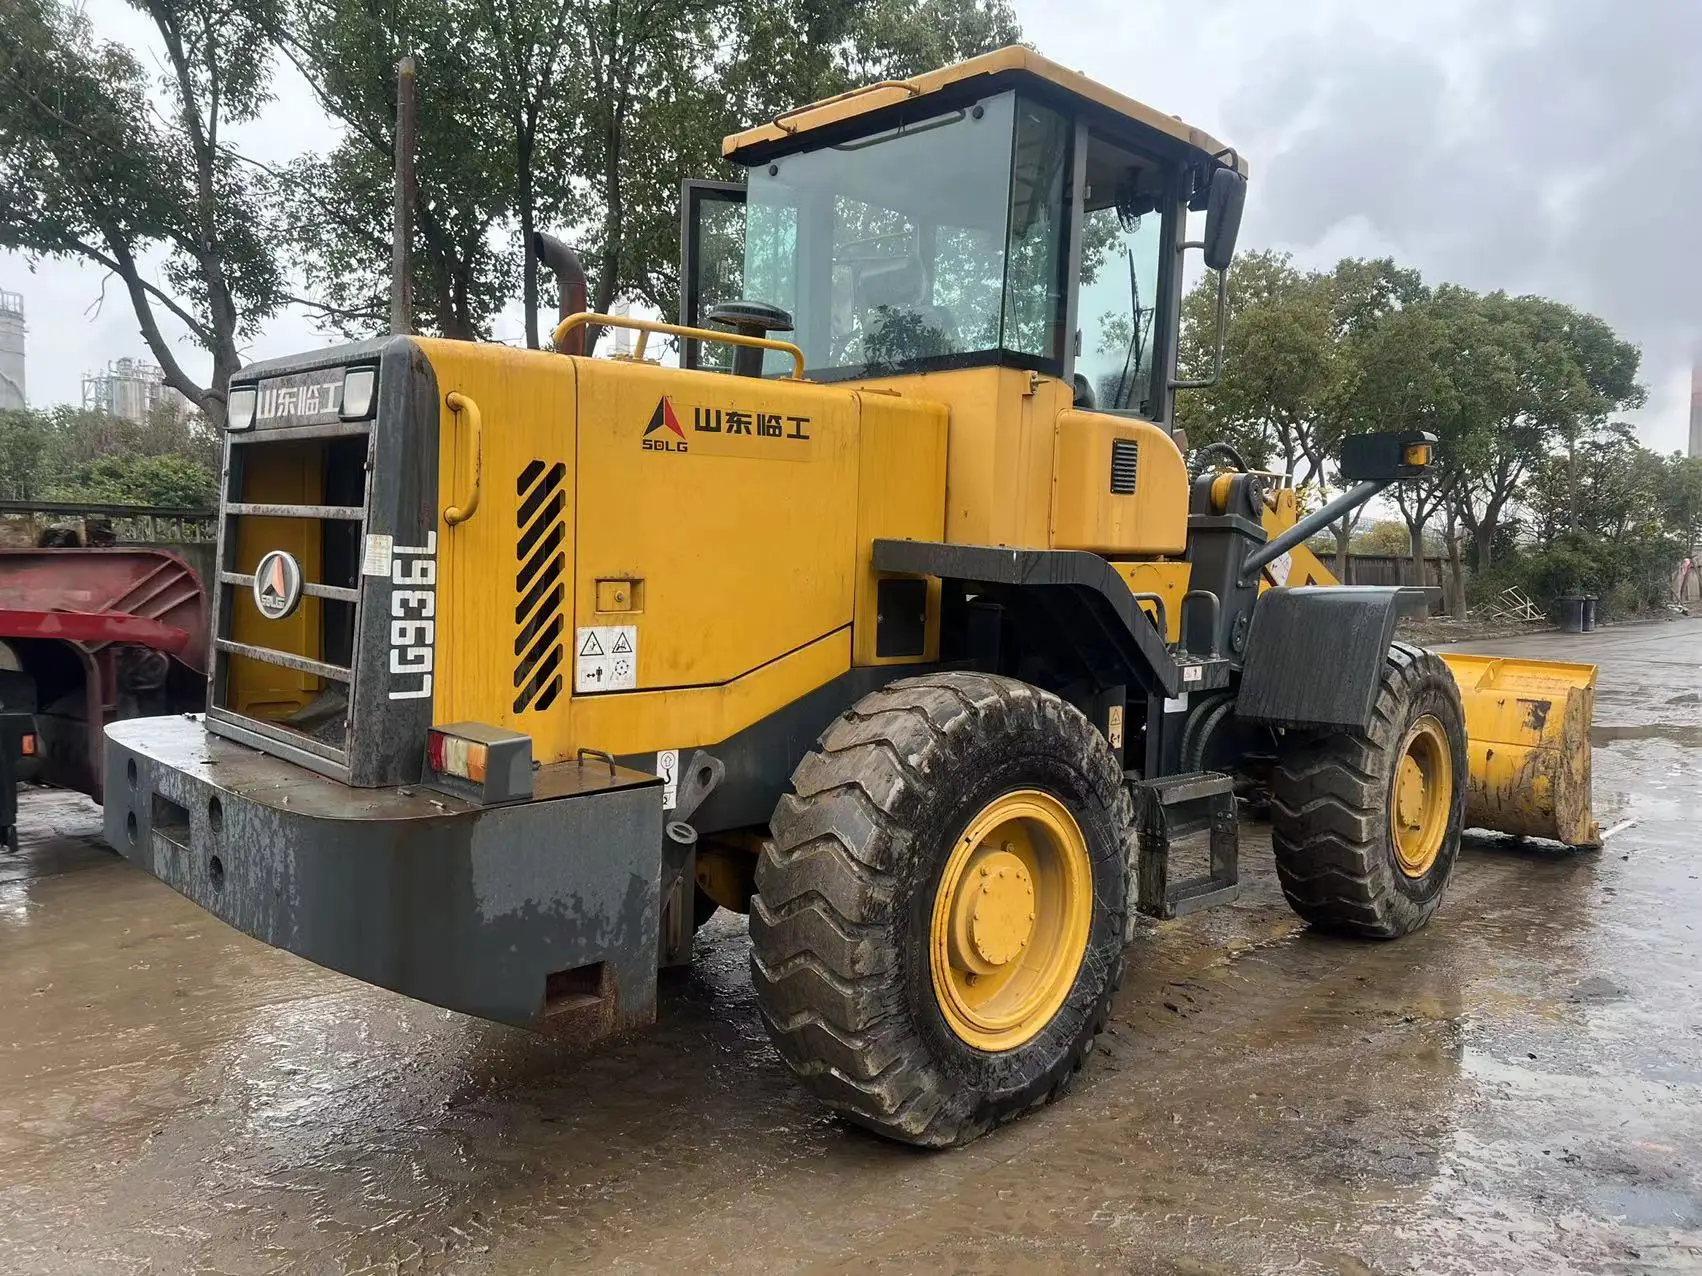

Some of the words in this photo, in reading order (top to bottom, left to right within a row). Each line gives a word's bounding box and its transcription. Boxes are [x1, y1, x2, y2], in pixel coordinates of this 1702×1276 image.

[256, 382, 343, 419] 山东临工
[694, 407, 810, 440] 山东临工
[642, 439, 688, 453] SDLG
[389, 531, 437, 700] LG936L
